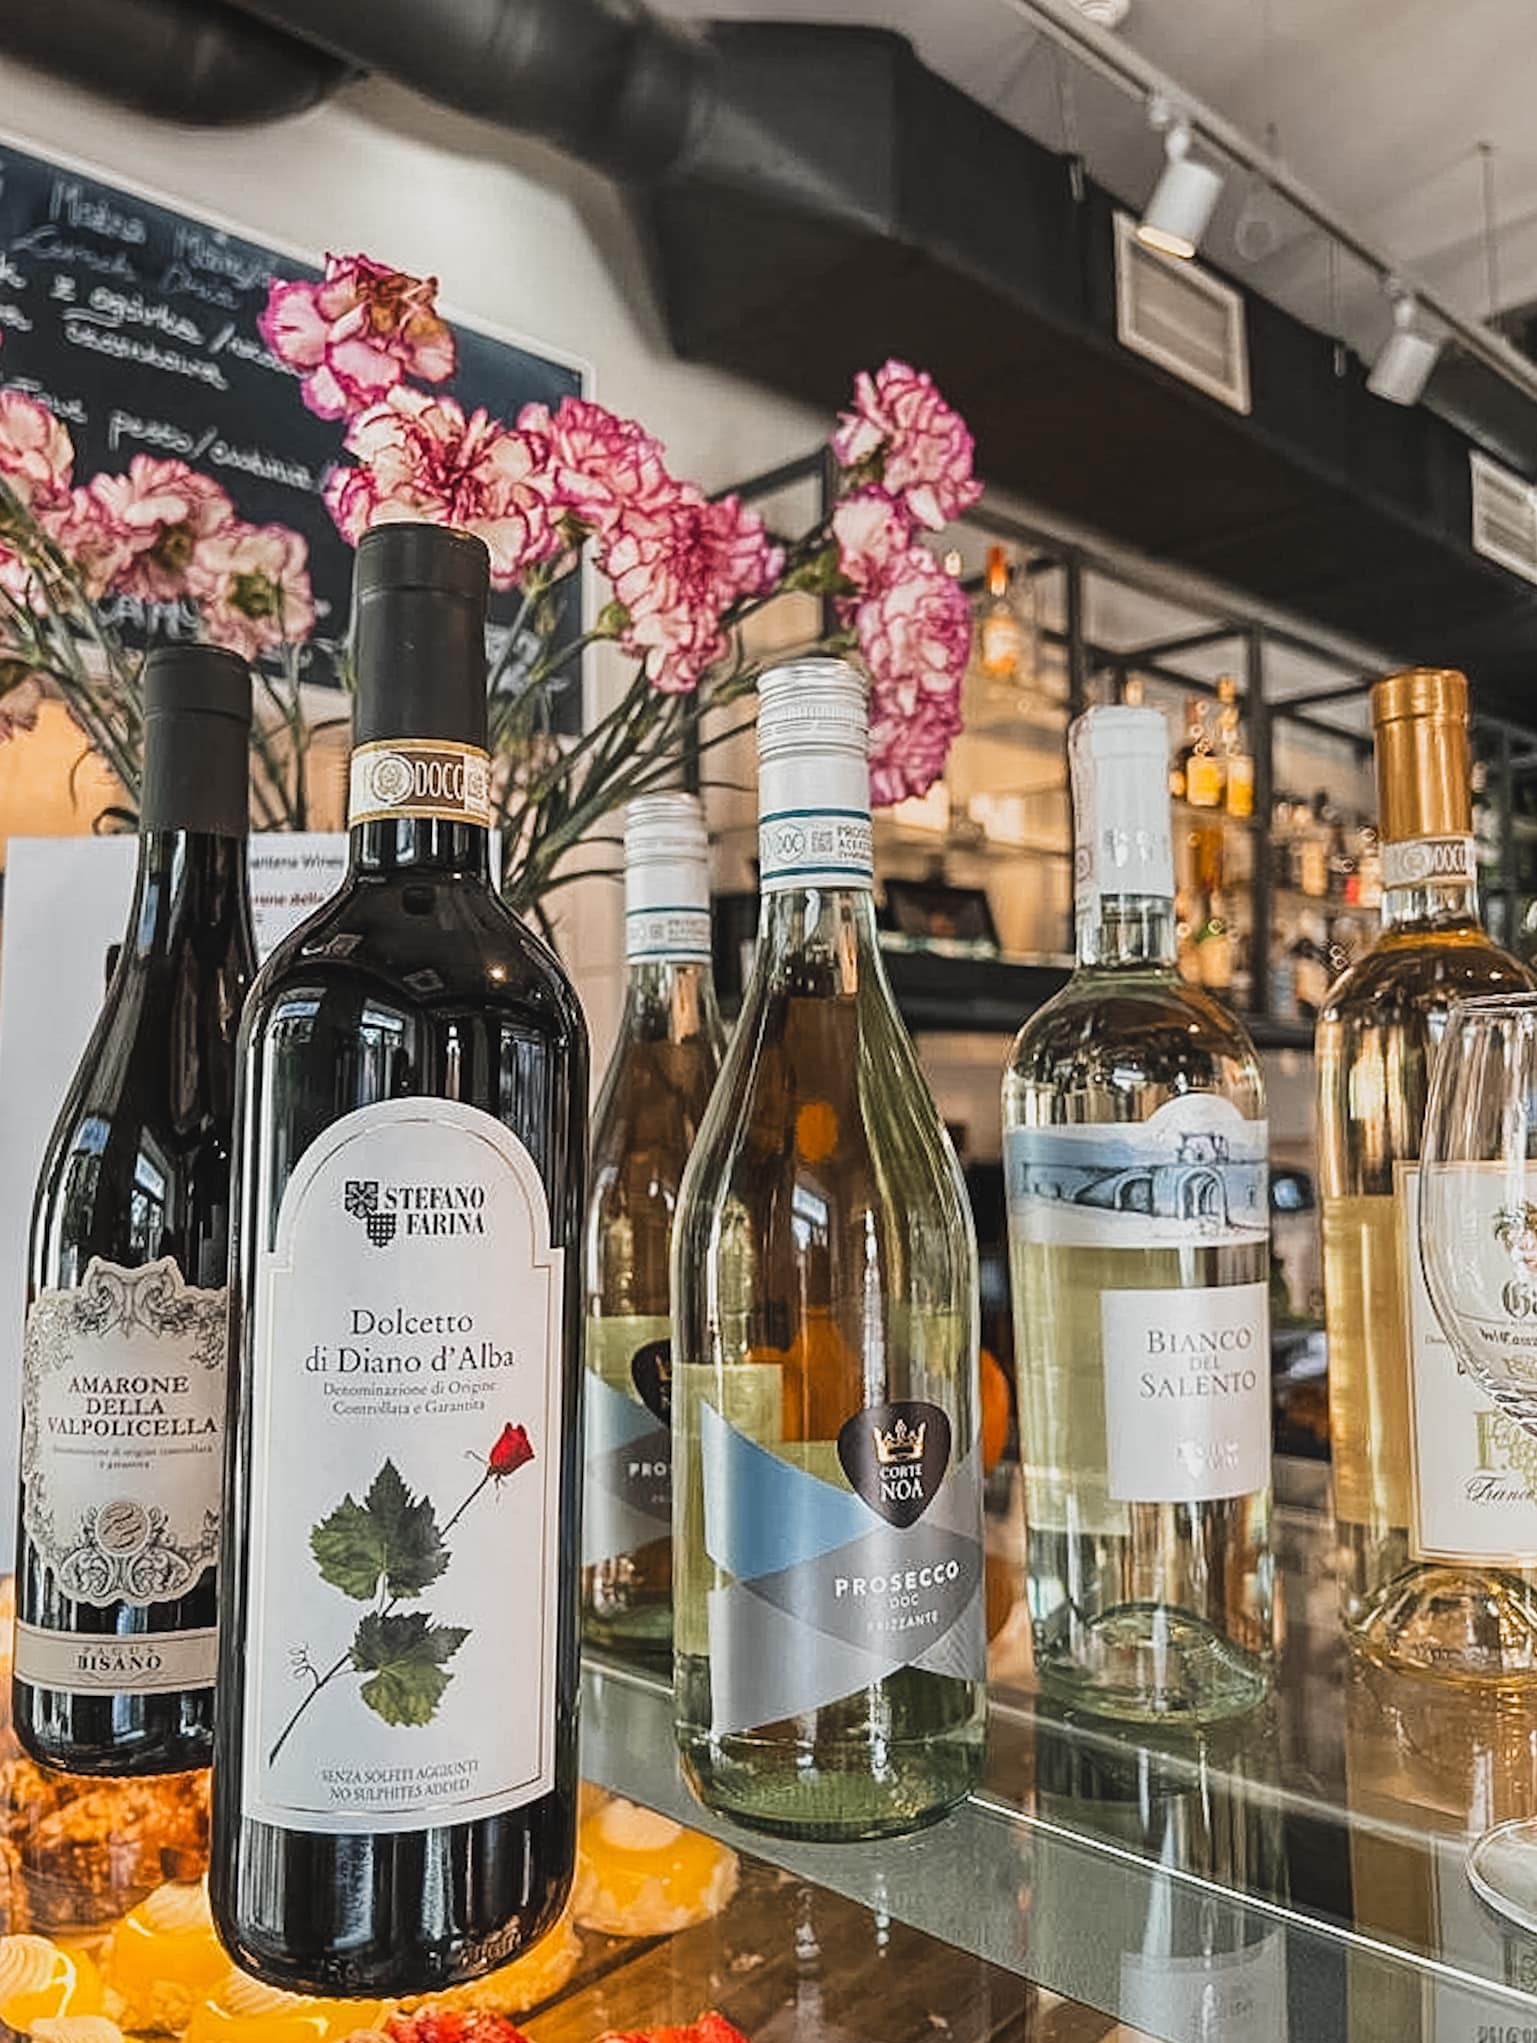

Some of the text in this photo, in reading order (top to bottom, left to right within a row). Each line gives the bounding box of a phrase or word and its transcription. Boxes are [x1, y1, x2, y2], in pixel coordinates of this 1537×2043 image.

[383, 1187, 486, 1210] STEFANO
[406, 1212, 485, 1236] FARINA
[350, 1308, 474, 1336] Dolcetto
[1147, 1327, 1252, 1354] BIANCO
[305, 1342, 515, 1374] di Diano d'Alba
[1190, 1355, 1221, 1371] DEL
[68, 1376, 190, 1394] AMARONE
[323, 1381, 427, 1397] Denominazione
[430, 1381, 444, 1396] di
[1140, 1369, 1257, 1399] SALENTO
[86, 1399, 165, 1416] DELLA
[48, 1416, 218, 1438] VALPOLICELLA
[629, 1461, 671, 1478] PRO
[880, 1463, 924, 1480] CORTE
[881, 1479, 924, 1502] NOA
[834, 1560, 961, 1598] PROSECCO
[889, 1593, 919, 1608] DOC
[867, 1610, 939, 1633] FRIZZANTE
[322, 1768, 362, 1783] SENZA
[329, 1778, 470, 1802] NO SULPHITES ADDED
